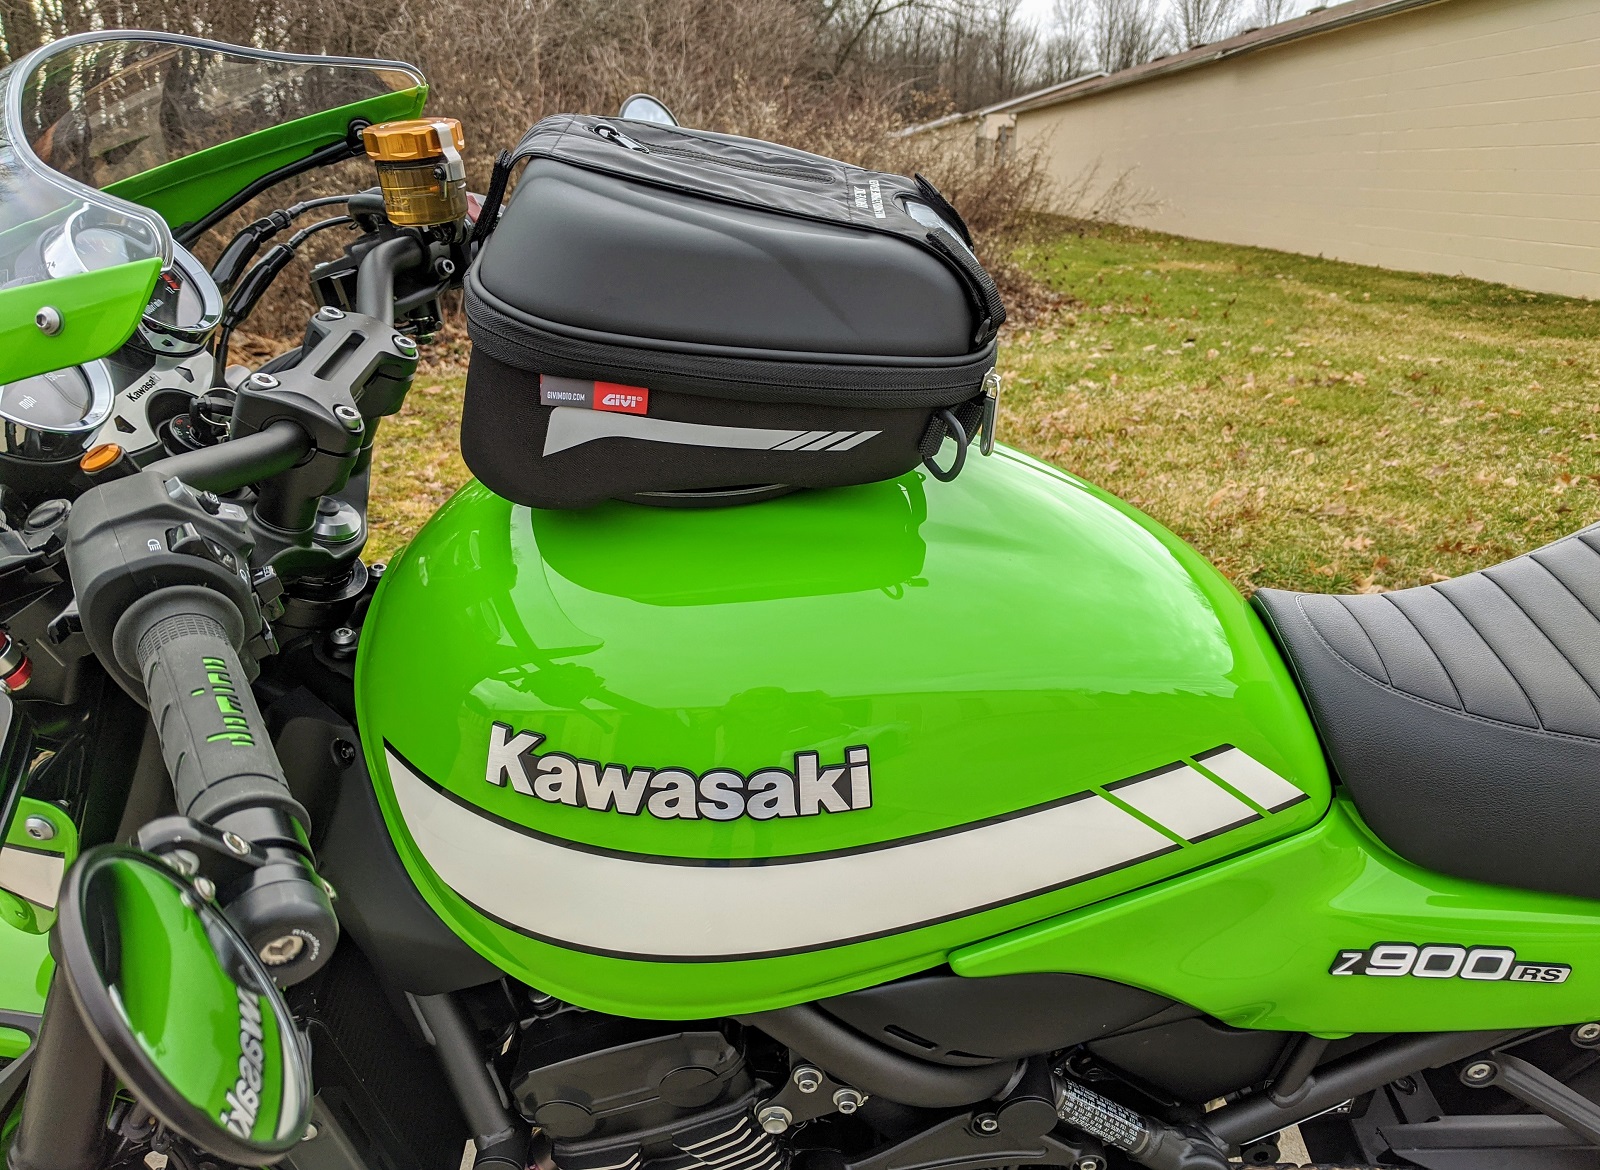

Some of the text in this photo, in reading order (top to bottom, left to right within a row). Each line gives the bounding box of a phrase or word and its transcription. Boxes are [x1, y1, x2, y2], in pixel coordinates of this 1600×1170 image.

[546, 391, 637, 408] GIVIMOTO.COM GIVI
[485, 720, 874, 822] Kawasaki
[1517, 967, 1563, 983] RS
